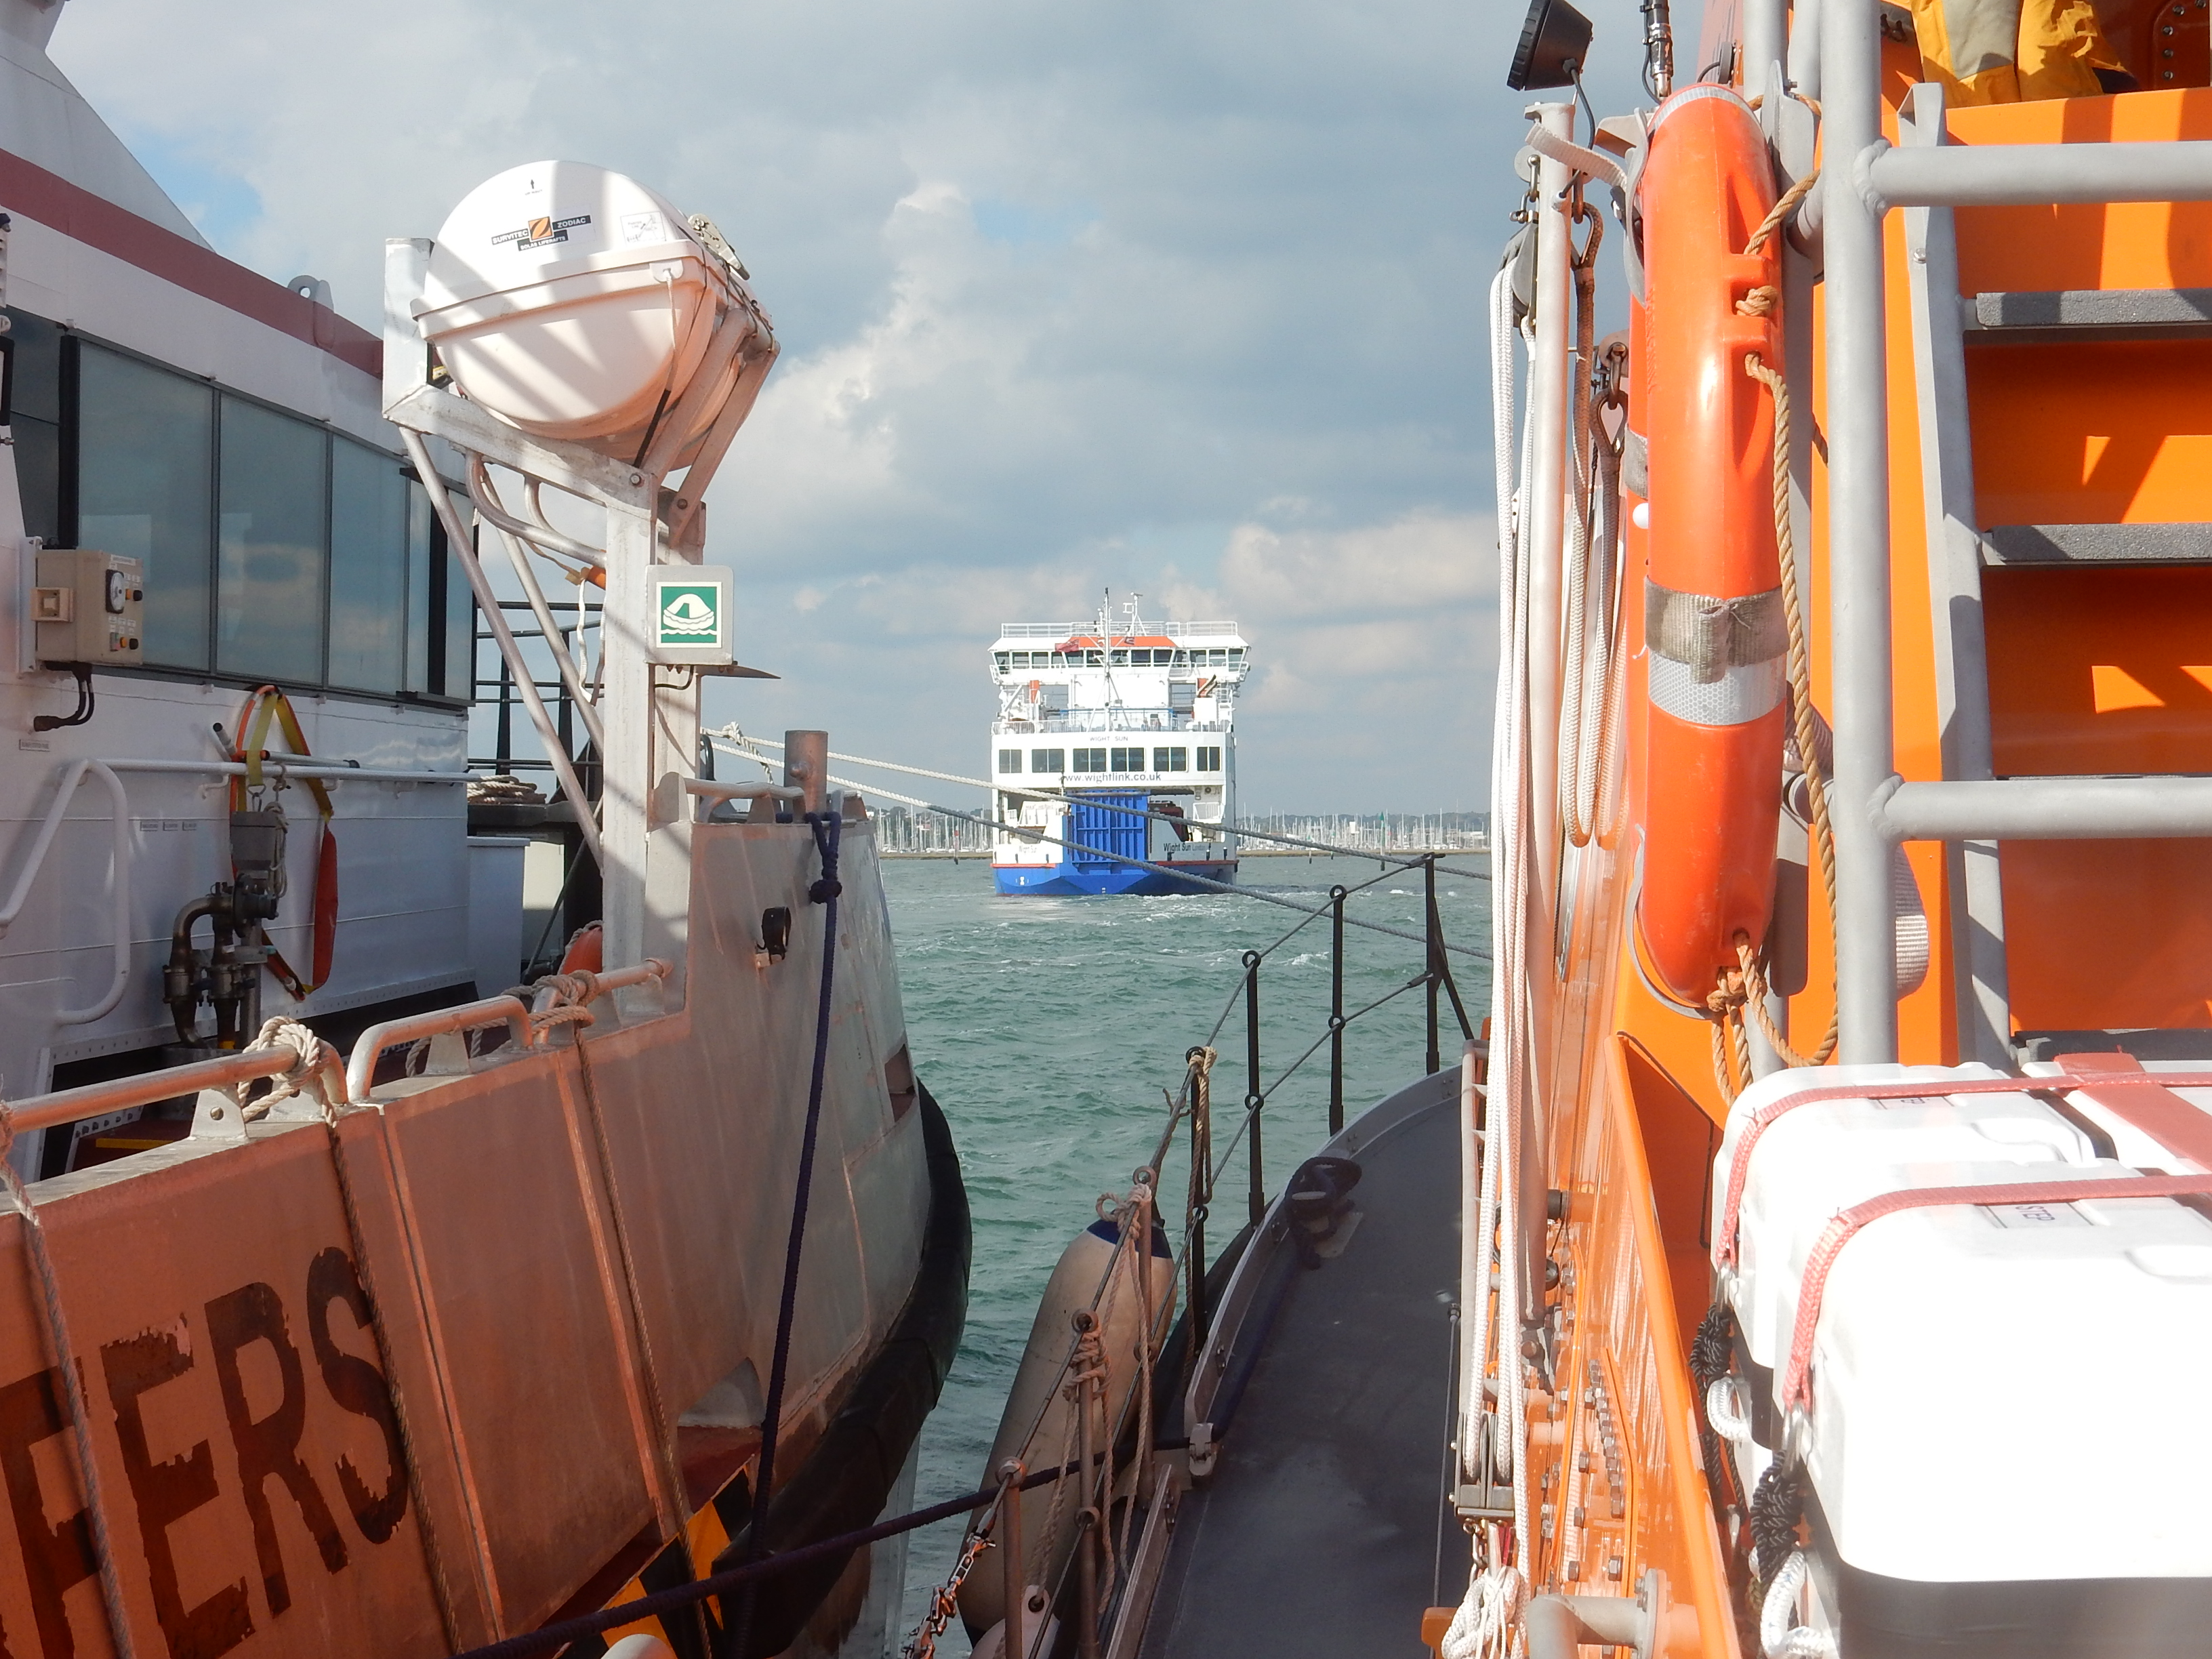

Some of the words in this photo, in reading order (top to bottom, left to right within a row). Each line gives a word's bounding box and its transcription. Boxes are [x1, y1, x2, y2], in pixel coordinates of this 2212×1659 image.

[492, 229, 529, 244] SURVITEC
[557, 218, 586, 228] ZODIAC
[538, 236, 566, 246] LIFERAFTS
[1164, 843, 1181, 853] Wight
[1182, 842, 1191, 851] Sun
[2015, 1205, 2055, 1221] STEP
[0, 1246, 408, 1659] FERS
